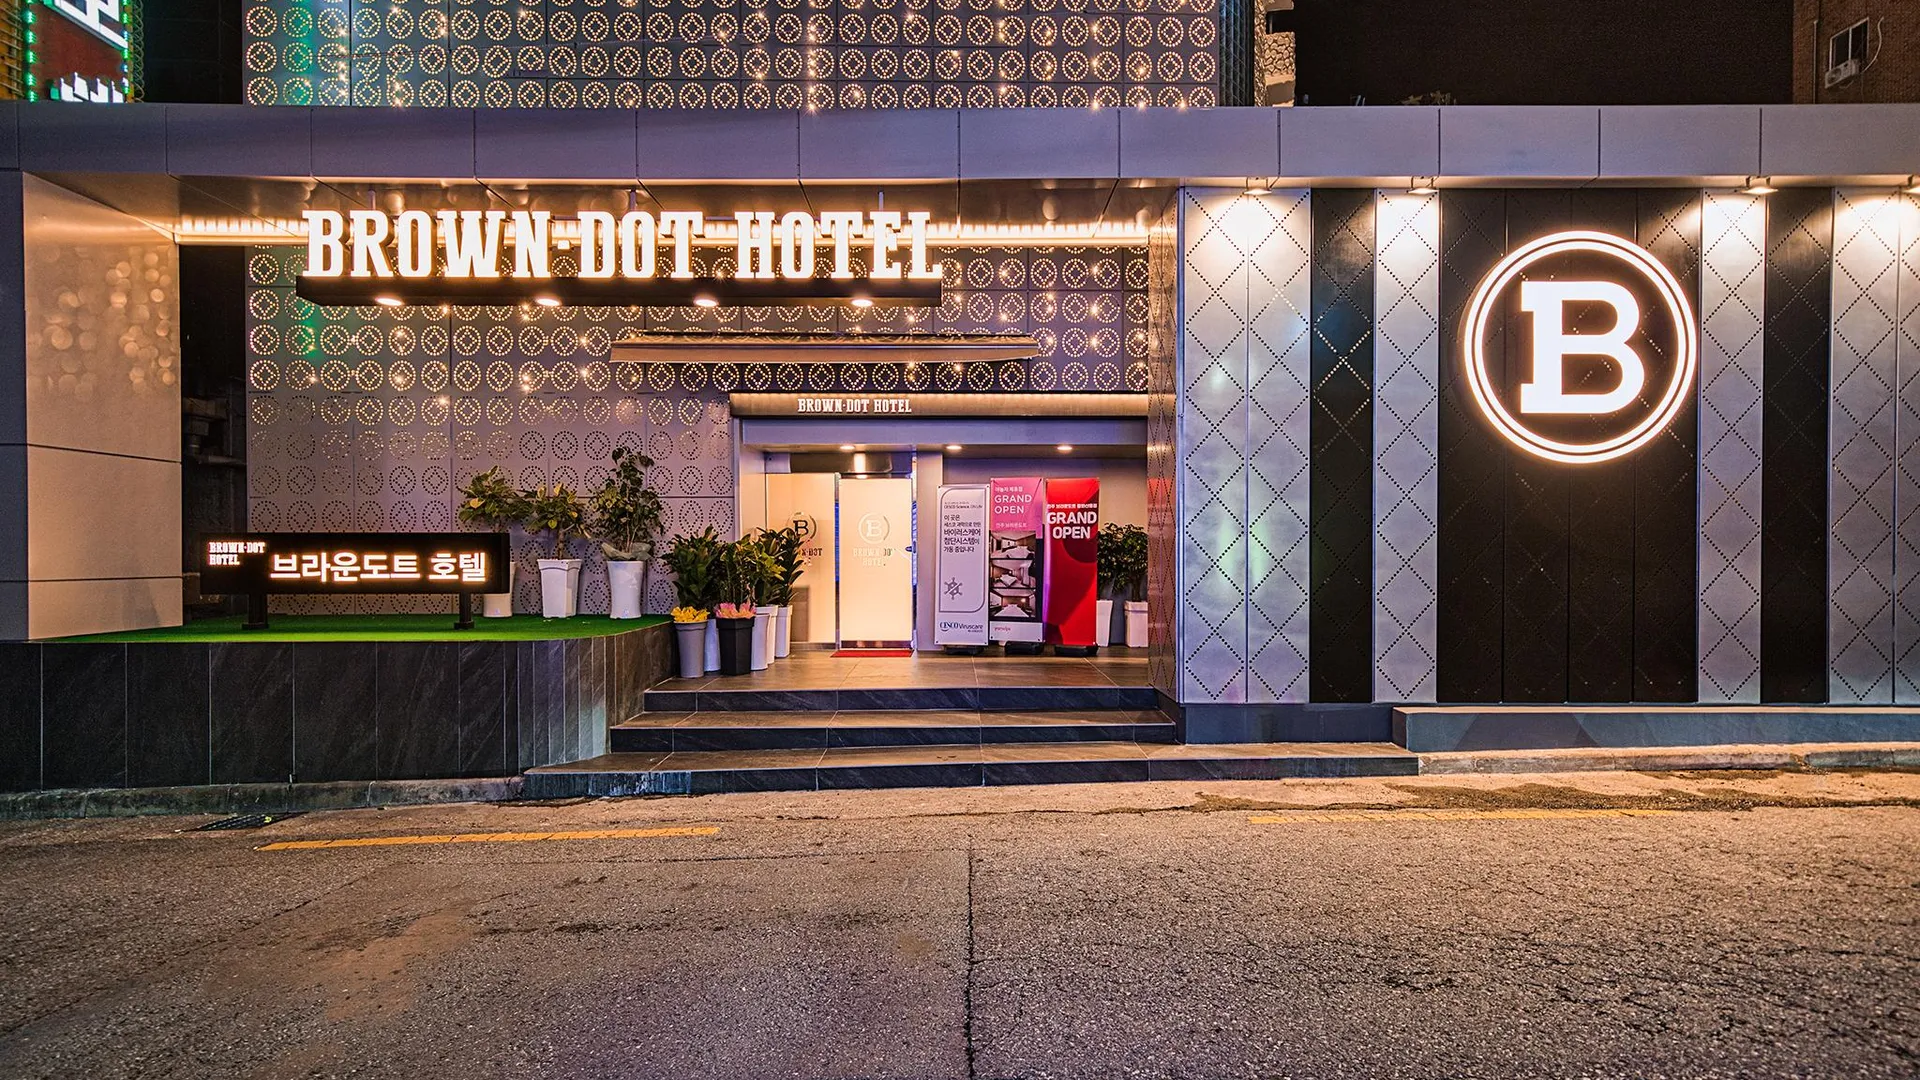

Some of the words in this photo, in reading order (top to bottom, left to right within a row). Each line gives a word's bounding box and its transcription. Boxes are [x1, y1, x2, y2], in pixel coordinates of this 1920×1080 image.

[734, 210, 943, 279] HOTEL
[1520, 280, 1646, 415] B
[873, 399, 912, 413] HOTEL
[994, 494, 1033, 504] GRAND
[994, 505, 1025, 515] OPEN
[1047, 511, 1098, 525] GRAND
[944, 528, 981, 537] 바이러스케어
[1052, 526, 1091, 540] OPEN
[209, 553, 241, 566] HOTEL
[270, 552, 420, 582] 브라운도트
[428, 552, 486, 582] 호텔
